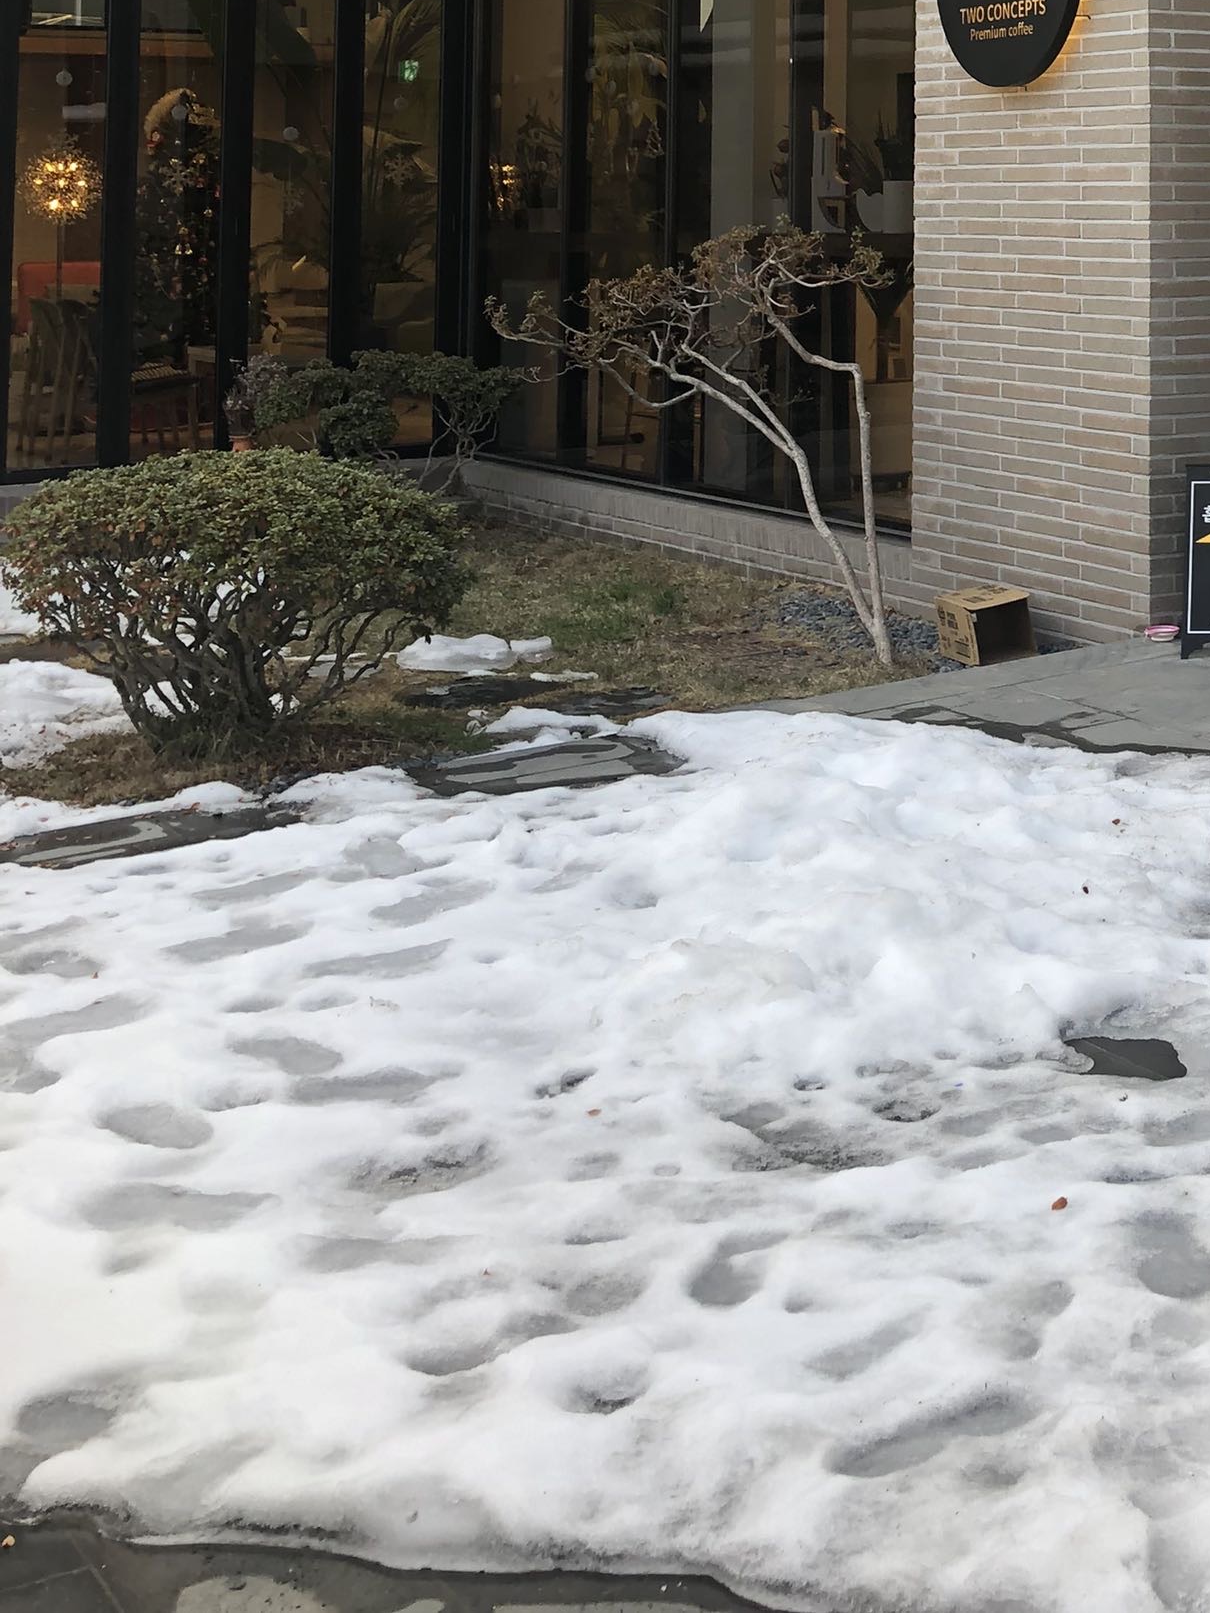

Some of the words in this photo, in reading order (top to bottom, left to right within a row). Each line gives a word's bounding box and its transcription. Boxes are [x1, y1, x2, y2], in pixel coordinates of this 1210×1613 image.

[960, 6, 984, 24] TWO
[970, 25, 1007, 41] Premium
[1008, 21, 1033, 37] coffee
